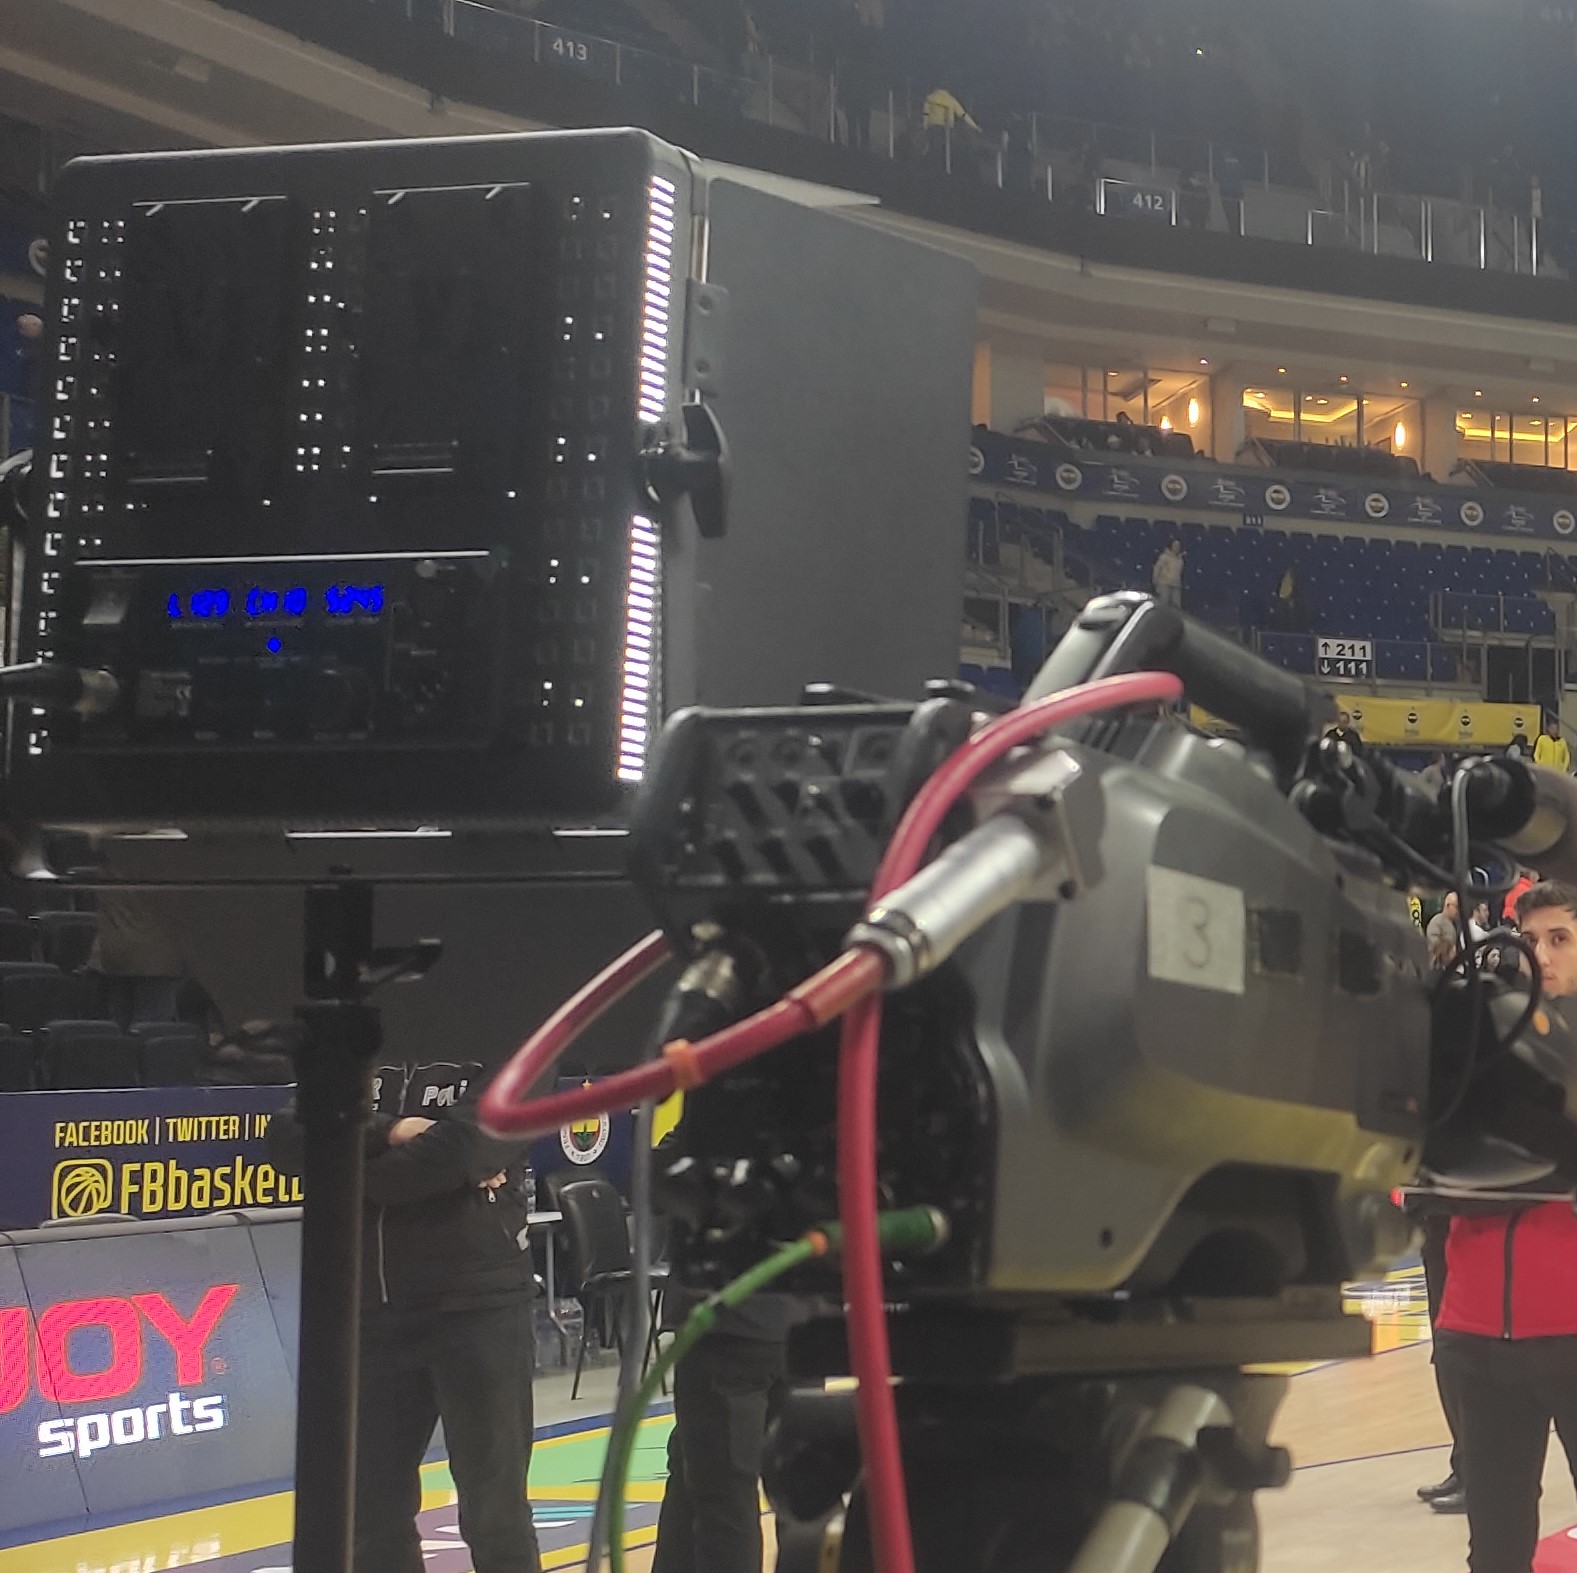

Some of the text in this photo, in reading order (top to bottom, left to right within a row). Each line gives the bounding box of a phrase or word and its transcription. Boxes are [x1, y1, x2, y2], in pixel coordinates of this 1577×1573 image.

[553, 37, 587, 61] 413
[1132, 191, 1164, 210] 412
[1335, 643, 1367, 658] 211
[1336, 660, 1367, 676] 111
[1179, 896, 1212, 969] 3
[54, 1119, 149, 1148] FACEBOOK
[165, 1115, 239, 1142] TWITTER
[38, 1392, 229, 1458] sports
